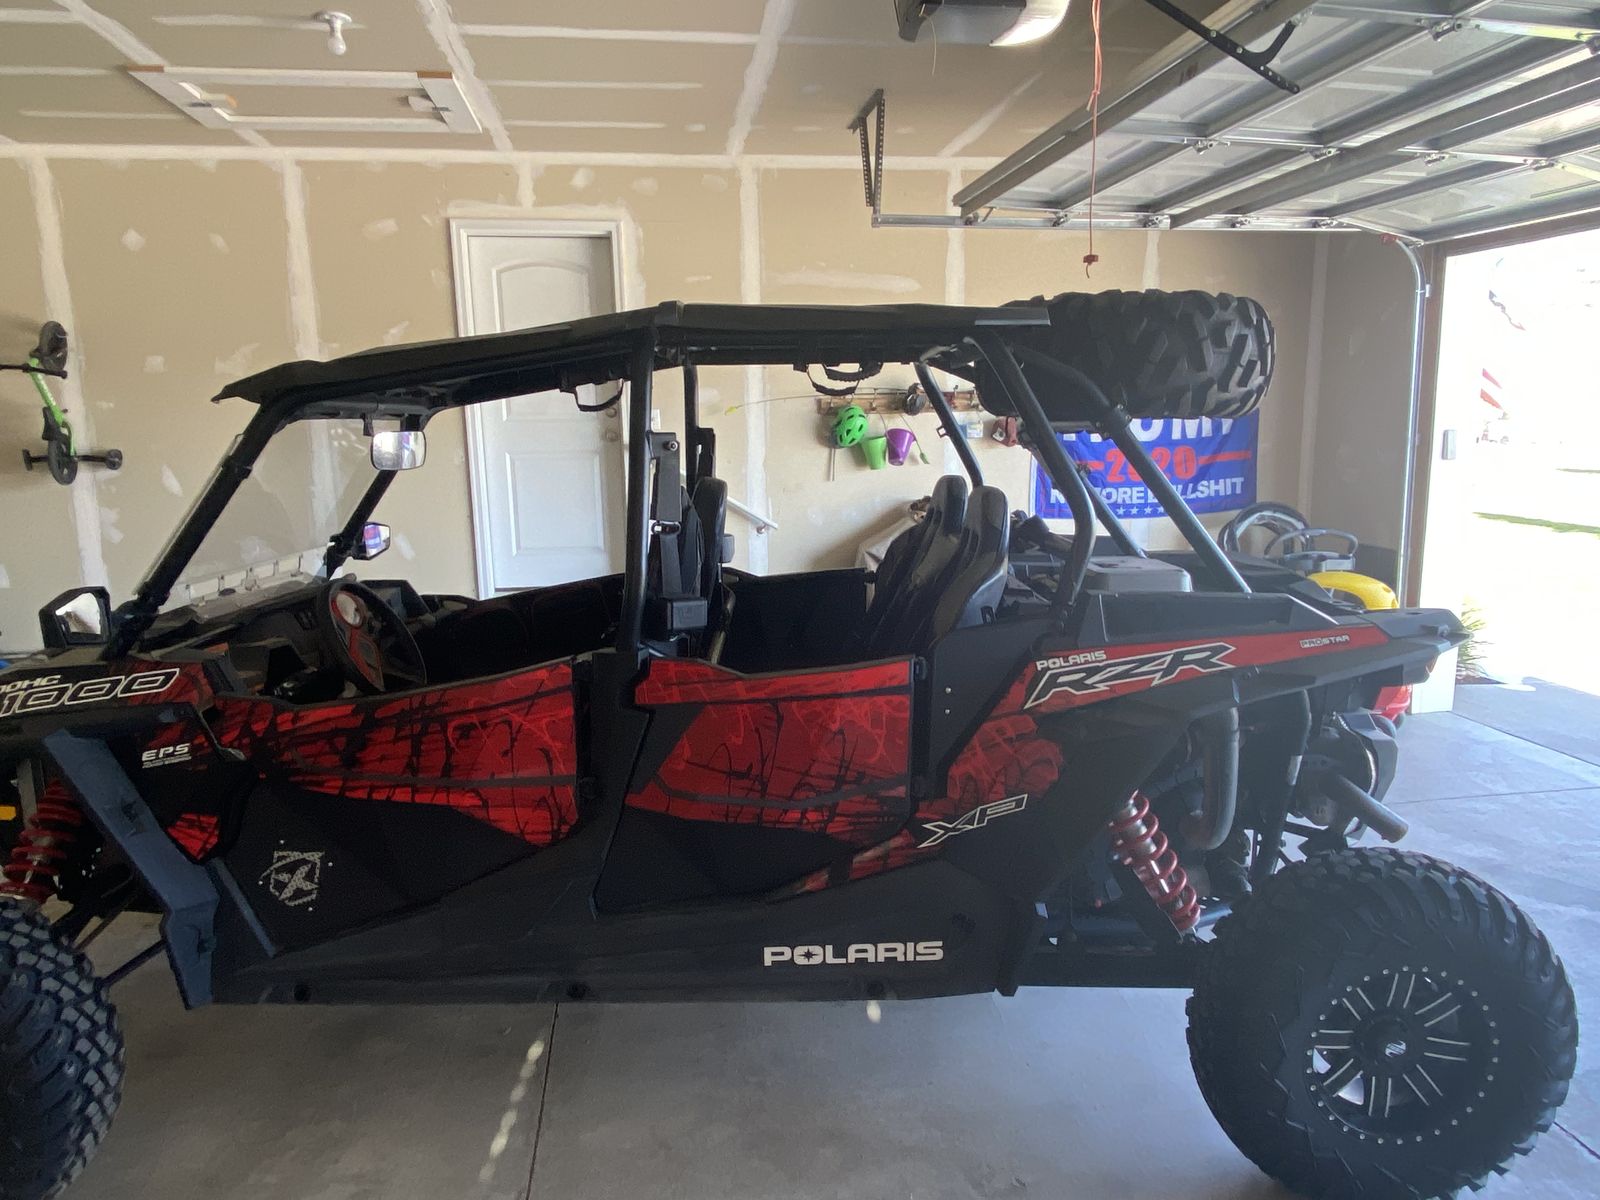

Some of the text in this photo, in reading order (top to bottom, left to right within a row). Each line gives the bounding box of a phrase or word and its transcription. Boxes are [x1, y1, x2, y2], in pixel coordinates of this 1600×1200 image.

[1093, 486, 1145, 504] ORE
[1299, 634, 1350, 648] PROSTAR
[1036, 650, 1107, 671] POLARIS
[1024, 642, 1236, 710] RZR
[0, 667, 180, 718] 1000
[142, 742, 191, 761] EPS
[916, 793, 1028, 848] XP
[763, 940, 944, 967] POLARIS
